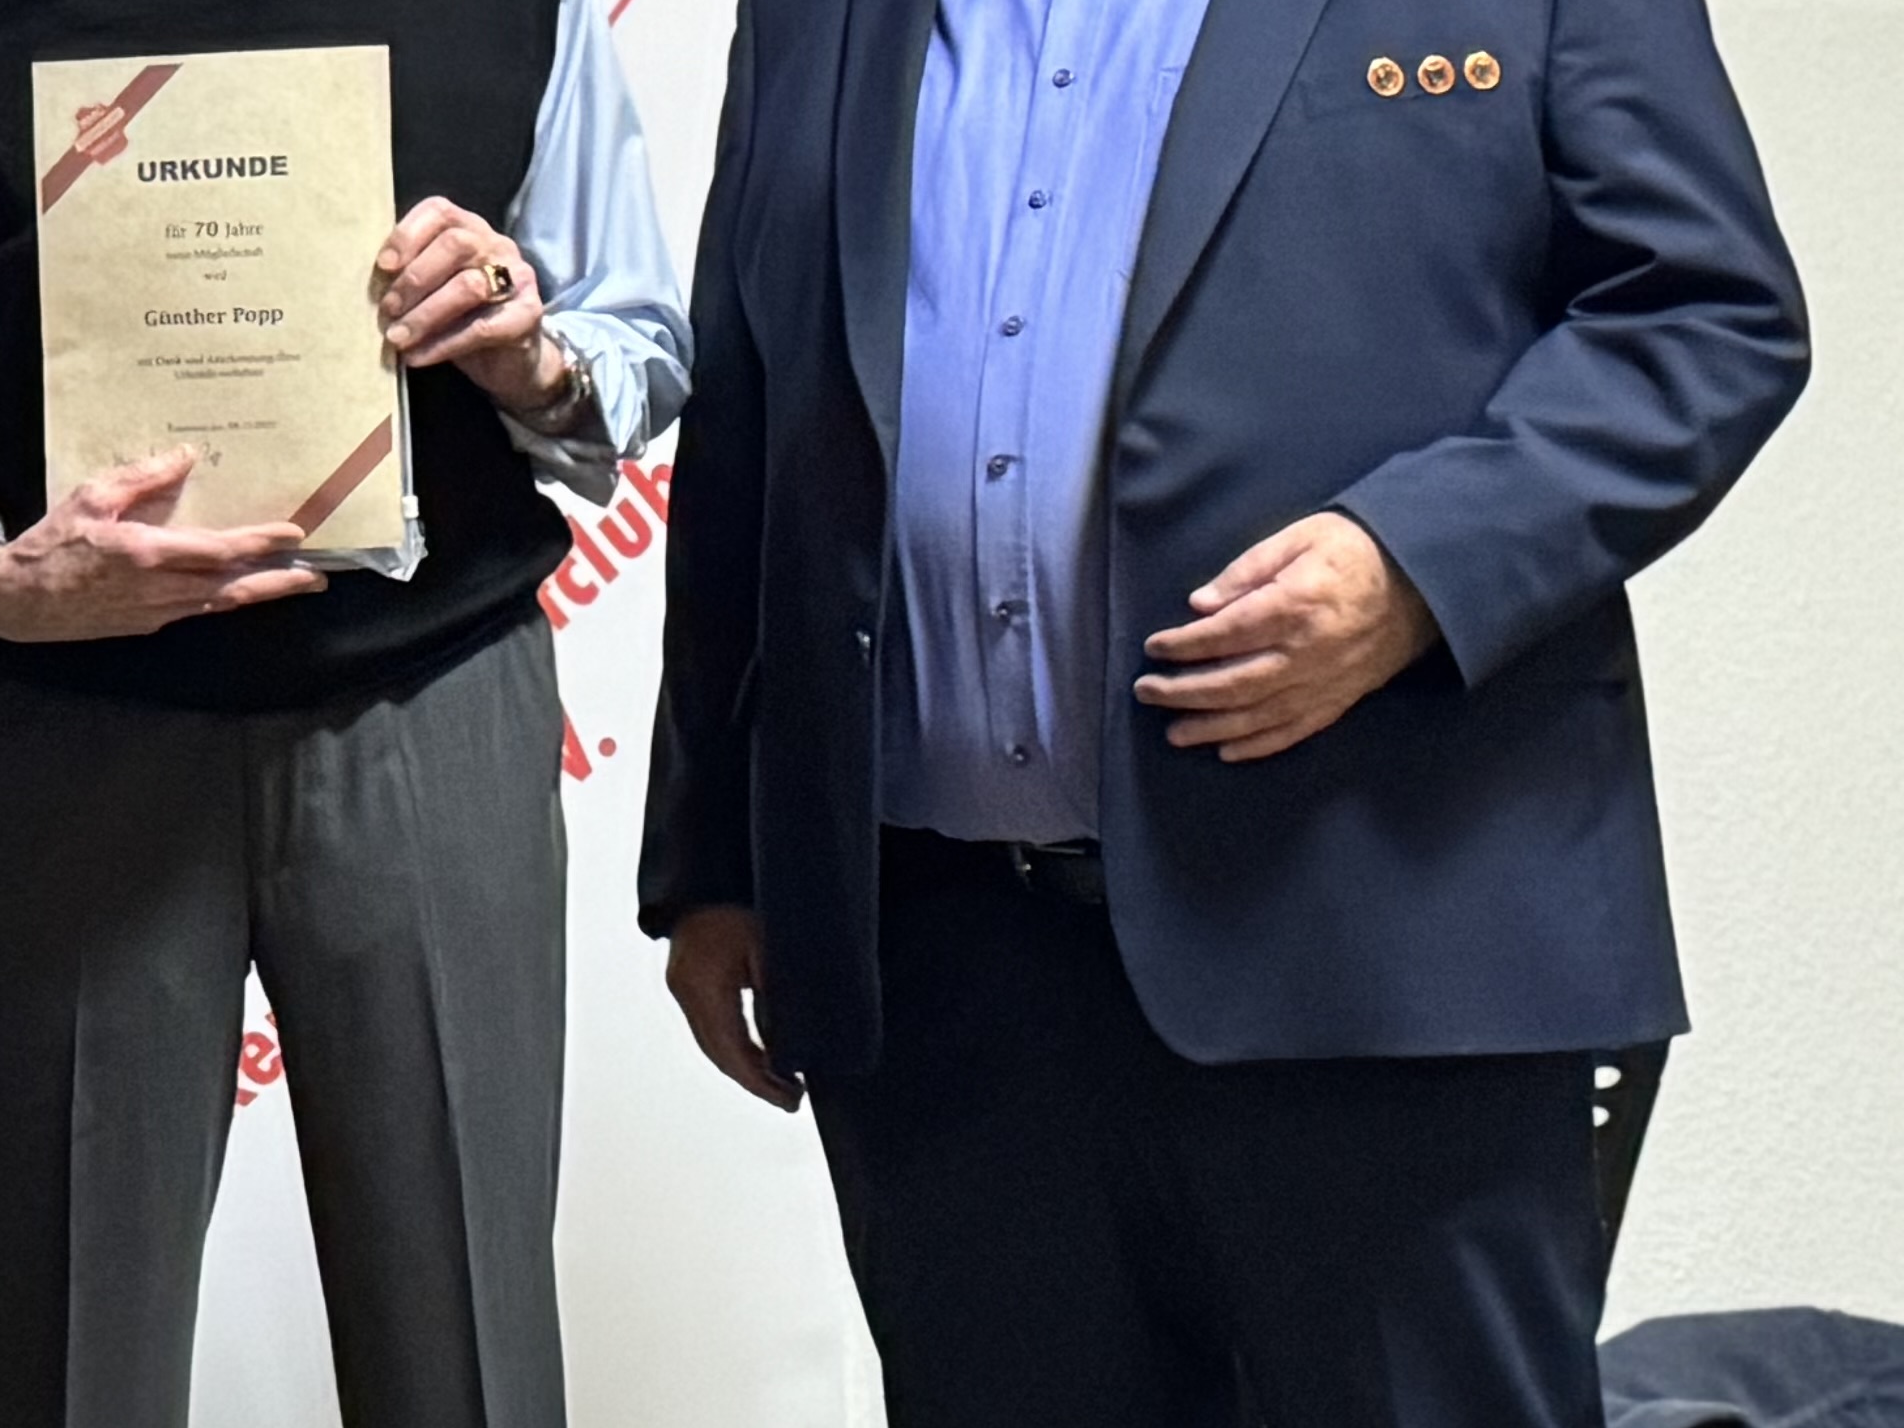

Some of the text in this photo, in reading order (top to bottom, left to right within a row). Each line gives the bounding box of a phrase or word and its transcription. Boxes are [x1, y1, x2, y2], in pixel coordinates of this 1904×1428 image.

[137, 155, 289, 183] URKUNDE
[194, 221, 219, 238] 70
[225, 222, 264, 238] Jahre
[144, 307, 284, 327] Günther Popp
